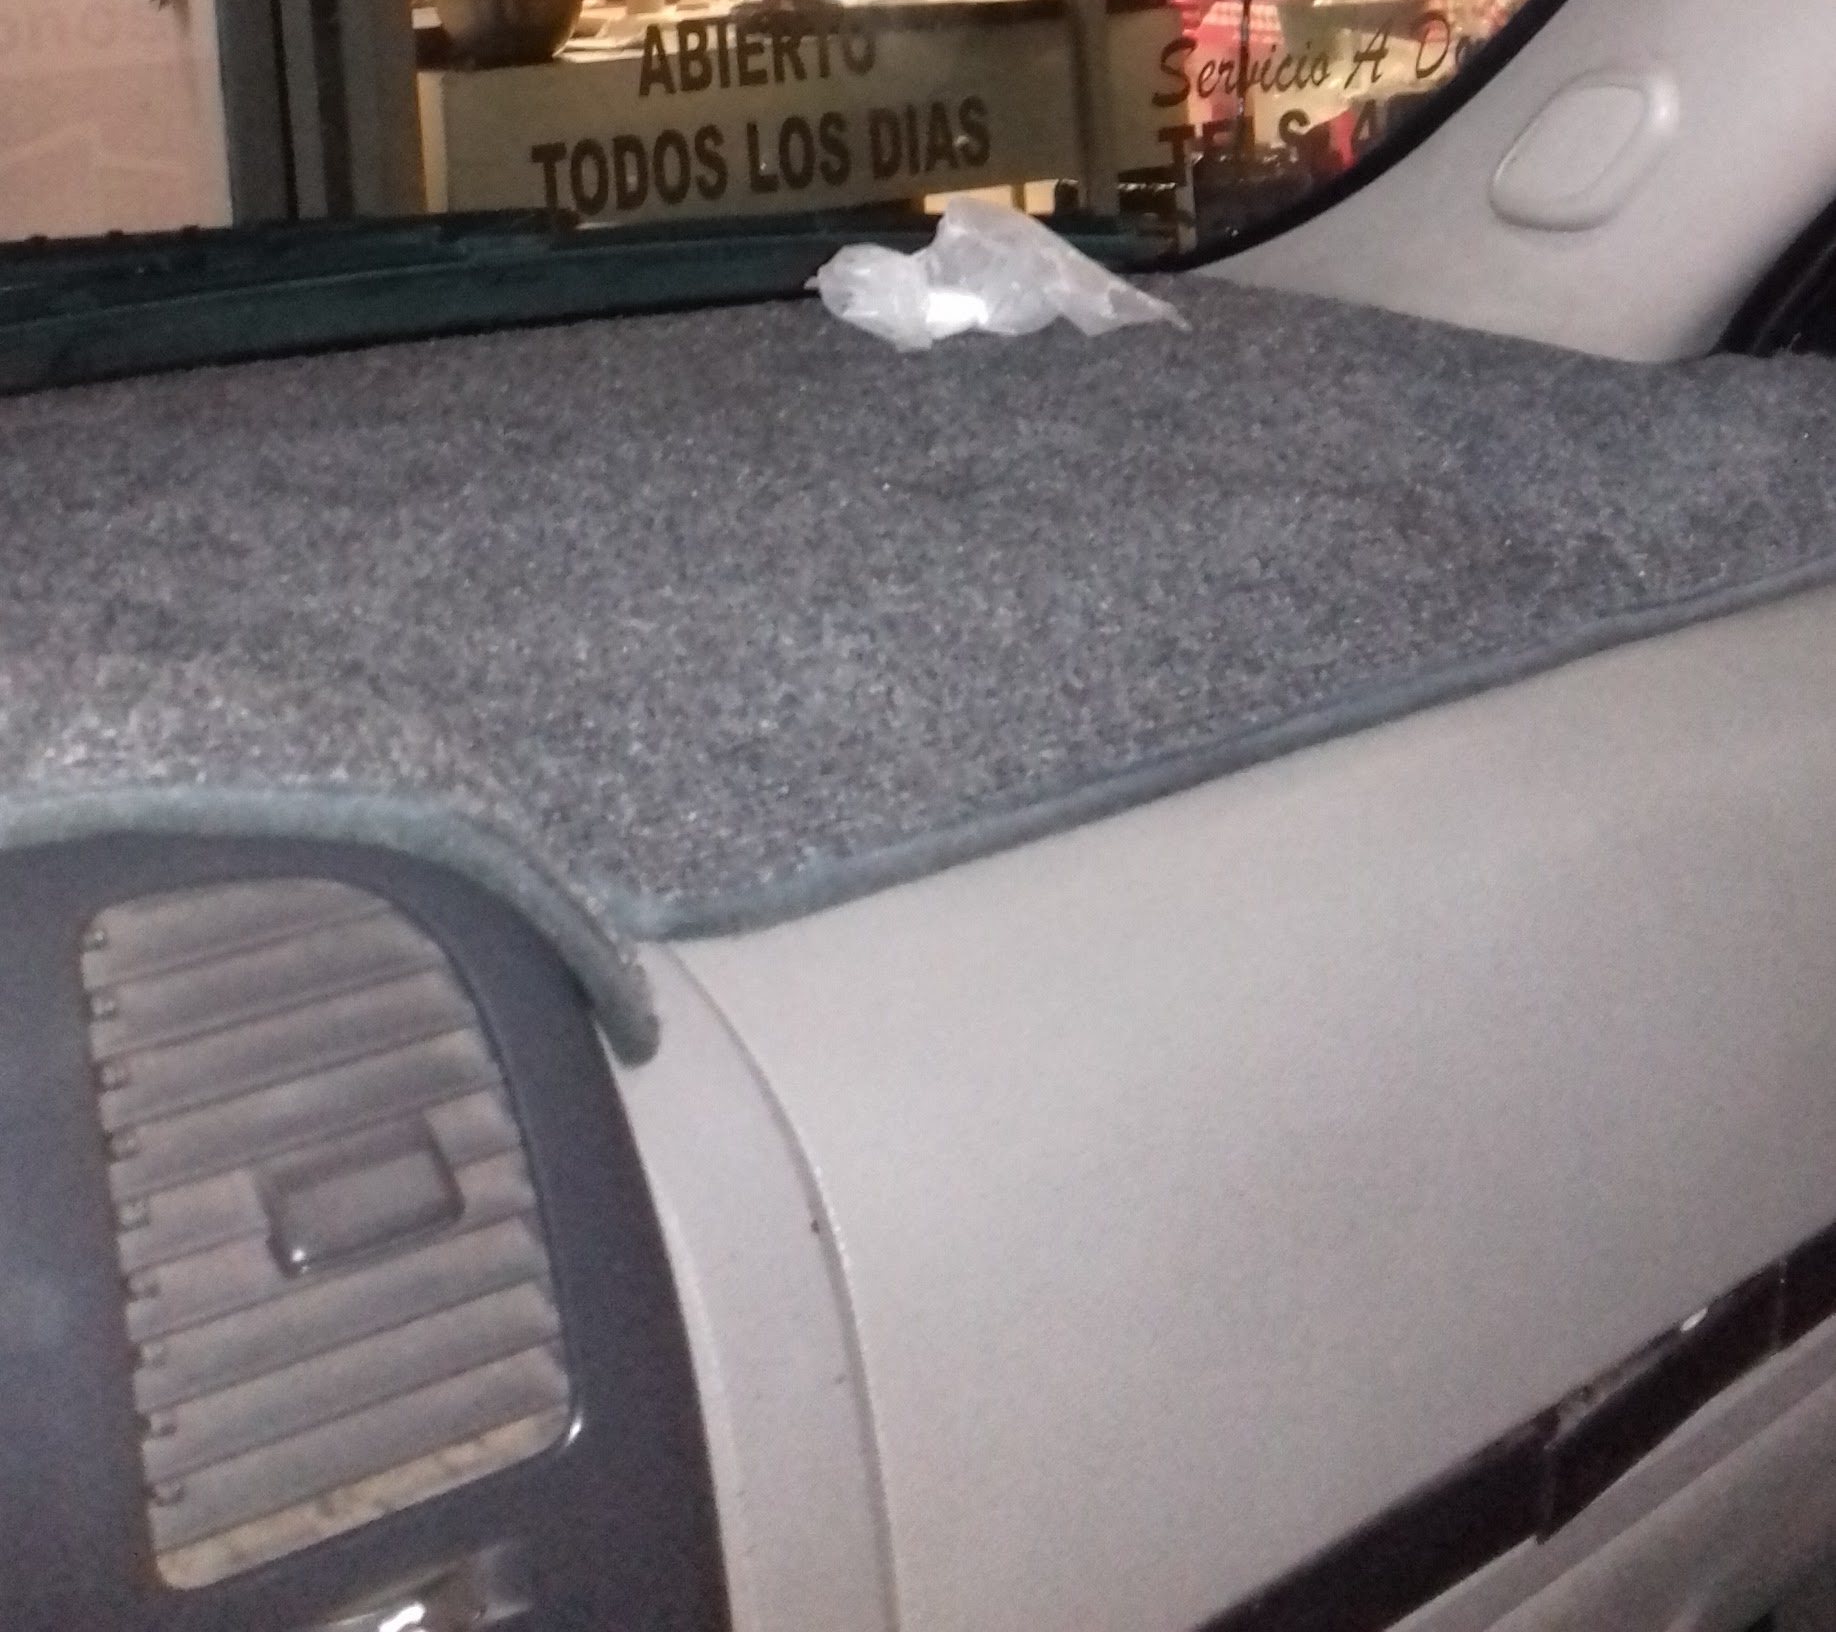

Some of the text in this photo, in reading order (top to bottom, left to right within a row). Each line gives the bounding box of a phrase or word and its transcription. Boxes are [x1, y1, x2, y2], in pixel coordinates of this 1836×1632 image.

[638, 15, 876, 97] ABIERTO
[1152, 36, 1332, 107] Servicio
[1345, 20, 1393, 89] A
[531, 94, 992, 216] TODOS LOS DIAS
